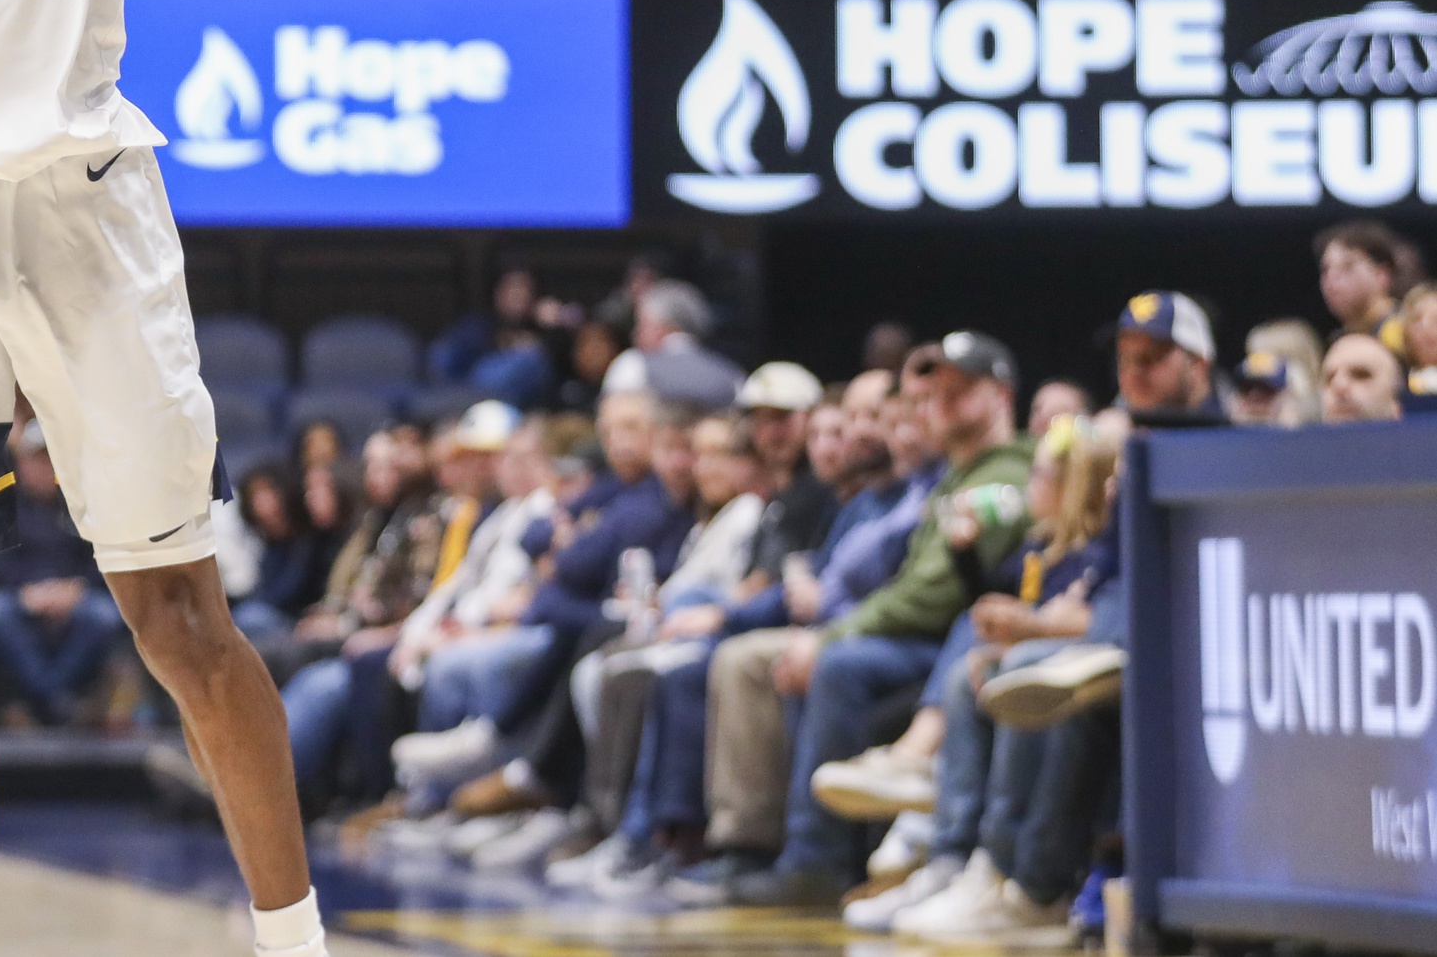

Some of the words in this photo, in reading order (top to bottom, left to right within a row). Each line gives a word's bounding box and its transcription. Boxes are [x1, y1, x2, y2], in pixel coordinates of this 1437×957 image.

[273, 25, 510, 113] Hope
[272, 98, 443, 175] Gas
[1247, 593, 1436, 737] UNITED
